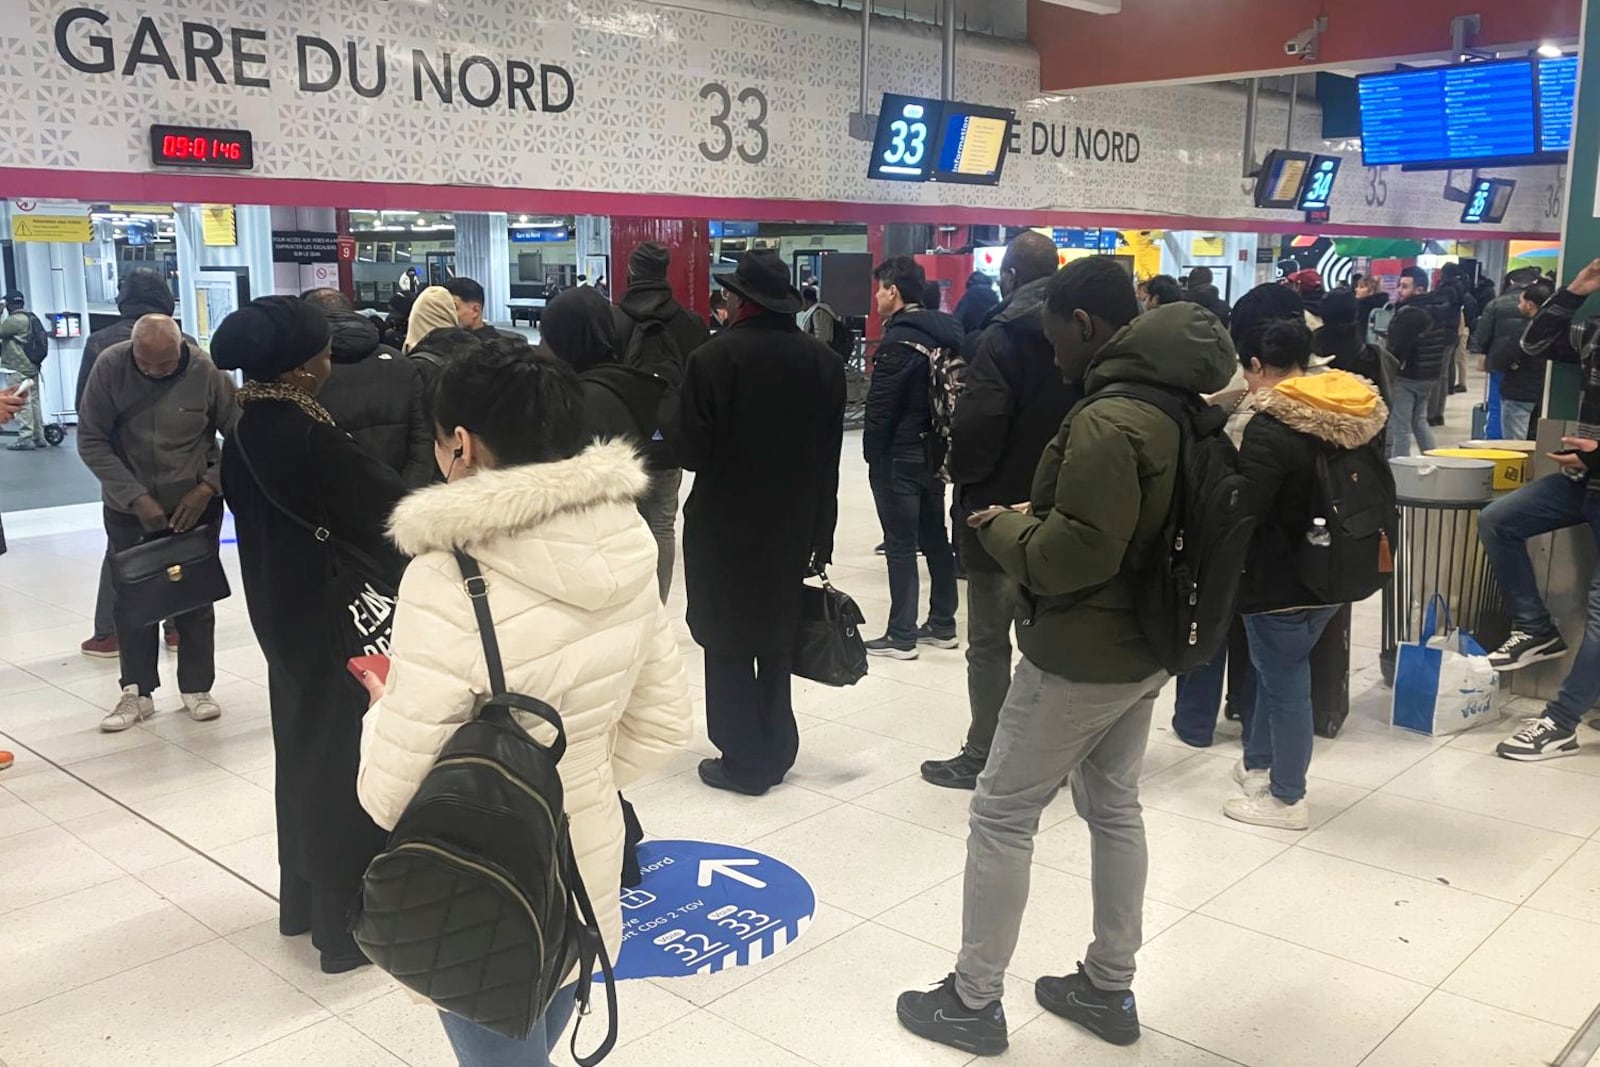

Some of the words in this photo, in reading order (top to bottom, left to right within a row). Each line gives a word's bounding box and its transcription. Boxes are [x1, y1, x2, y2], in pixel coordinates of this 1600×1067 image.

[54, 6, 271, 89] GARE
[298, 34, 387, 99] DU
[412, 49, 575, 113] NORD
[698, 82, 769, 164] 33
[883, 119, 927, 165] 33
[1031, 121, 1066, 157] DU
[1075, 126, 1140, 163] NORD
[952, 115, 970, 173] Information
[1306, 171, 1333, 200] 34
[1365, 166, 1388, 207] 35
[1468, 190, 1488, 215] 35
[1545, 184, 1561, 218] 36
[343, 247, 350, 258] 9
[640, 856, 675, 875] Nord
[638, 917, 667, 932] CDG
[667, 911, 679, 919] 2
[677, 899, 704, 913] TGV
[664, 933, 722, 961] 32
[718, 909, 770, 935] 33
